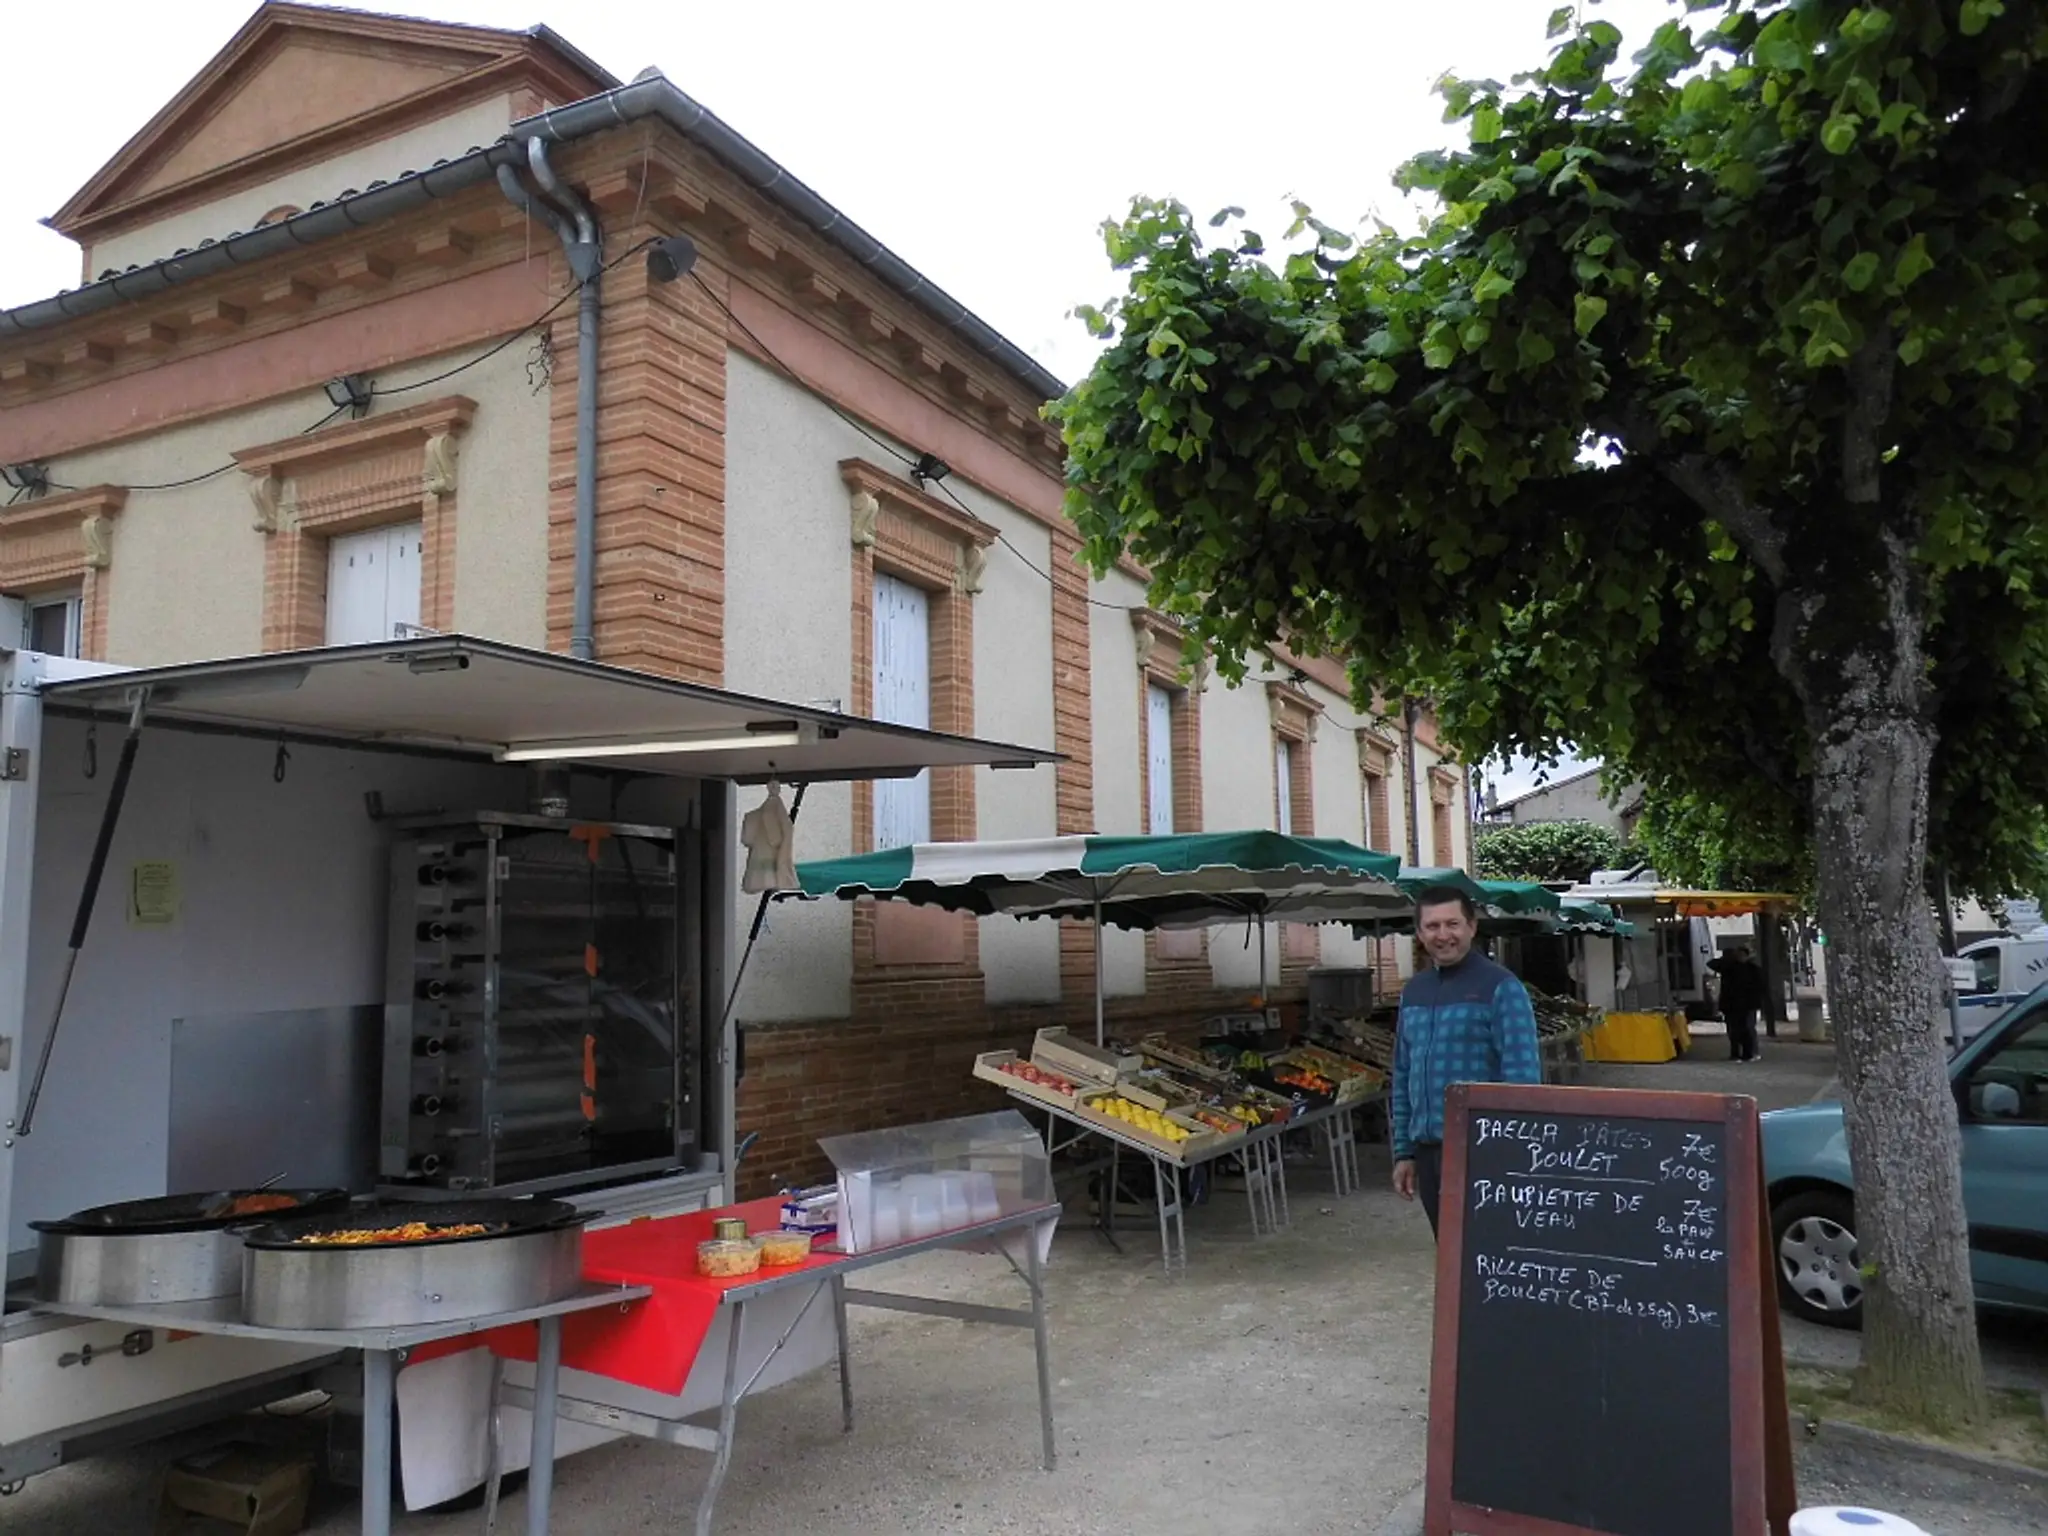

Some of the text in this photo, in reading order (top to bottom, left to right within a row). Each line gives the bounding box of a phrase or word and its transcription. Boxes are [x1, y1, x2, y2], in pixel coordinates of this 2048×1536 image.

[1476, 1117, 1558, 1145] PAELLA
[1526, 1143, 1619, 1172] POULET
[1682, 1133, 1716, 1163] 7€
[1659, 1157, 1715, 1191] 500g
[1613, 1191, 1645, 1213] DE
[1683, 1200, 1718, 1224] 7€
[1516, 1209, 1575, 1229] VEAU
[1664, 1244, 1723, 1261] SAUCE
[1482, 1278, 1569, 1303] POULET
[1588, 1269, 1623, 1289] DE
